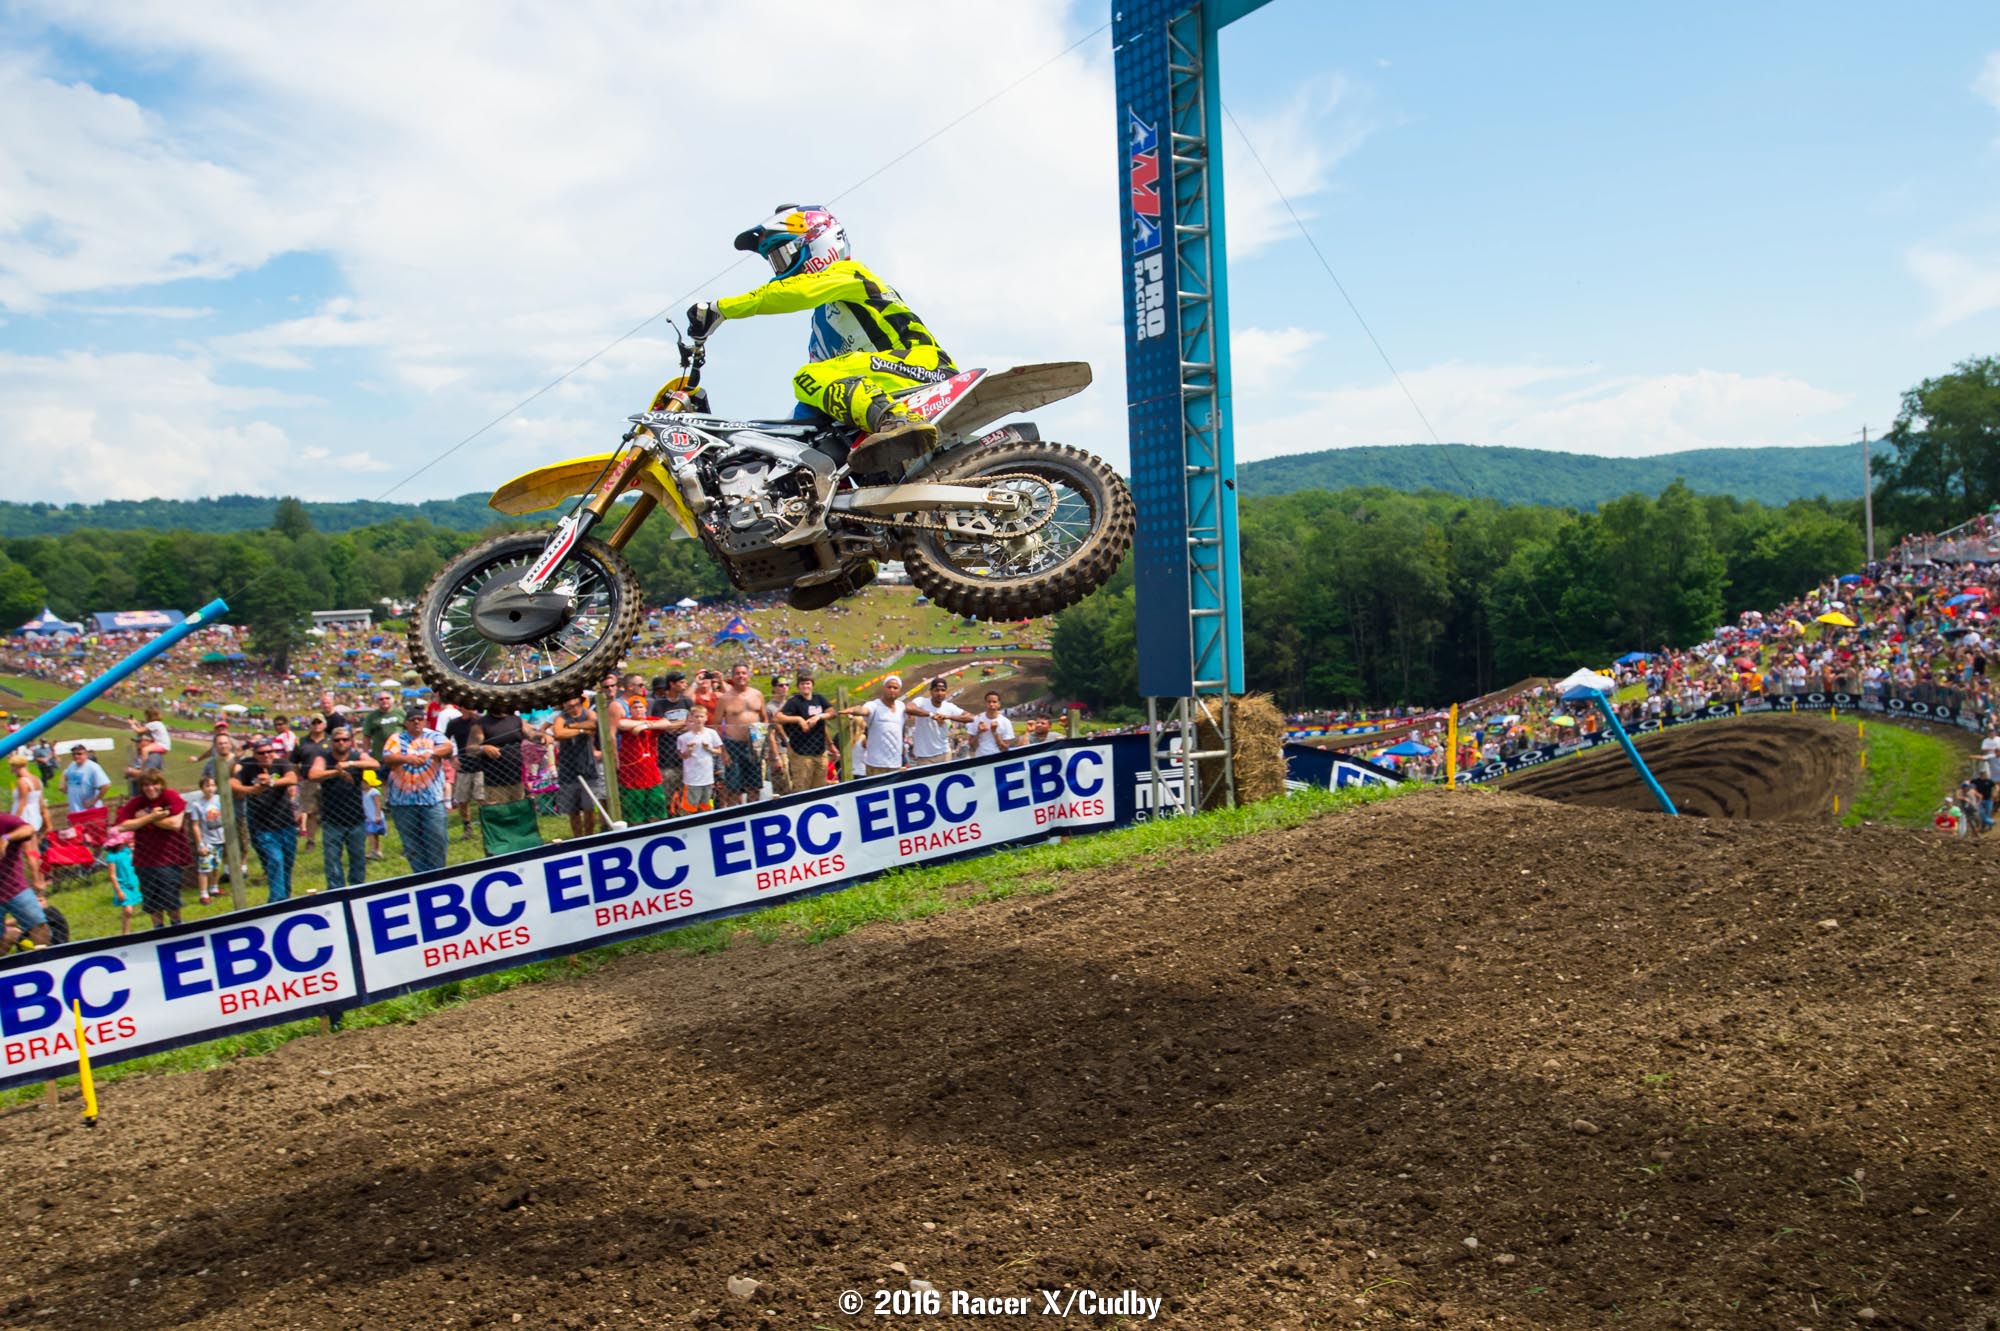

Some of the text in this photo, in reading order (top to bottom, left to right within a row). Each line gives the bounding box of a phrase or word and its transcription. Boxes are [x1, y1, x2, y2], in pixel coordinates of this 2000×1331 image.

[1128, 103, 1162, 256] AMA
[811, 247, 839, 272] Bull
[1134, 260, 1146, 342] RACING
[1144, 252, 1166, 338] PRO
[921, 396, 952, 416] Eagle
[527, 532, 568, 583] DUNLOP
[856, 774, 978, 843] EBC
[994, 750, 1104, 812] EBC
[709, 803, 842, 877] EBC
[899, 823, 982, 856] BRAKES
[1034, 799, 1104, 825] BRAKES
[544, 836, 690, 914] EBC
[756, 854, 846, 890] BRAKES
[367, 871, 526, 955] EBC
[595, 889, 693, 927] BRAKES
[156, 913, 334, 1001] EBC
[423, 926, 531, 968] BRAKES
[219, 971, 339, 1015] BRAKES
